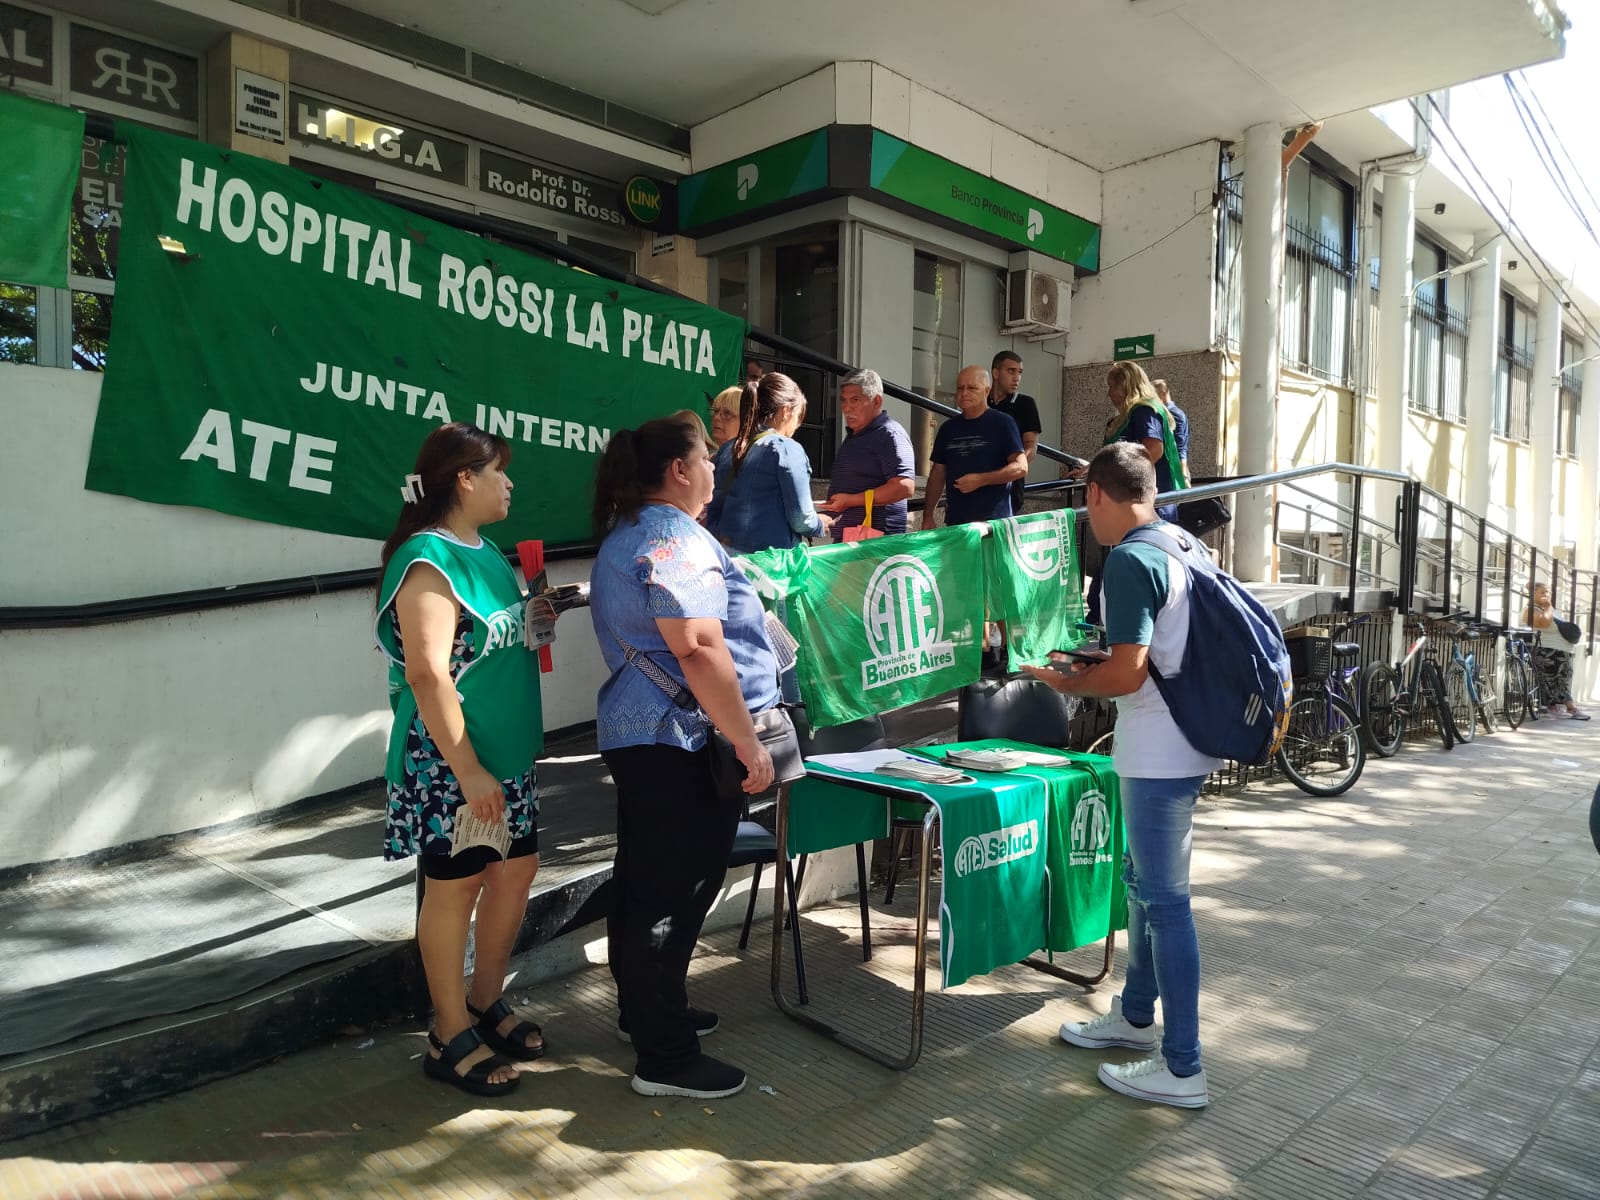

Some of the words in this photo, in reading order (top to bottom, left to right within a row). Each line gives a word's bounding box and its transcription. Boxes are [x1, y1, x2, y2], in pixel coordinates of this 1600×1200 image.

[487, 170, 568, 209] Rodolfo
[531, 168, 567, 190] Prof.
[572, 180, 592, 197] Dr.
[631, 189, 660, 211] LINK
[951, 185, 980, 208] Banco
[982, 198, 1025, 226] Provincia
[176, 158, 422, 300] HOSPITAL
[438, 253, 555, 338] ROSSI
[566, 293, 609, 353] LA
[622, 308, 717, 377] PLATA
[300, 362, 452, 424] JUNTA
[180, 408, 337, 495] ATE
[870, 565, 937, 657] ATE
[865, 662, 917, 686] Buenos
[920, 650, 953, 670] Aires
[958, 842, 982, 875] ATE
[988, 827, 1033, 861] Salud
